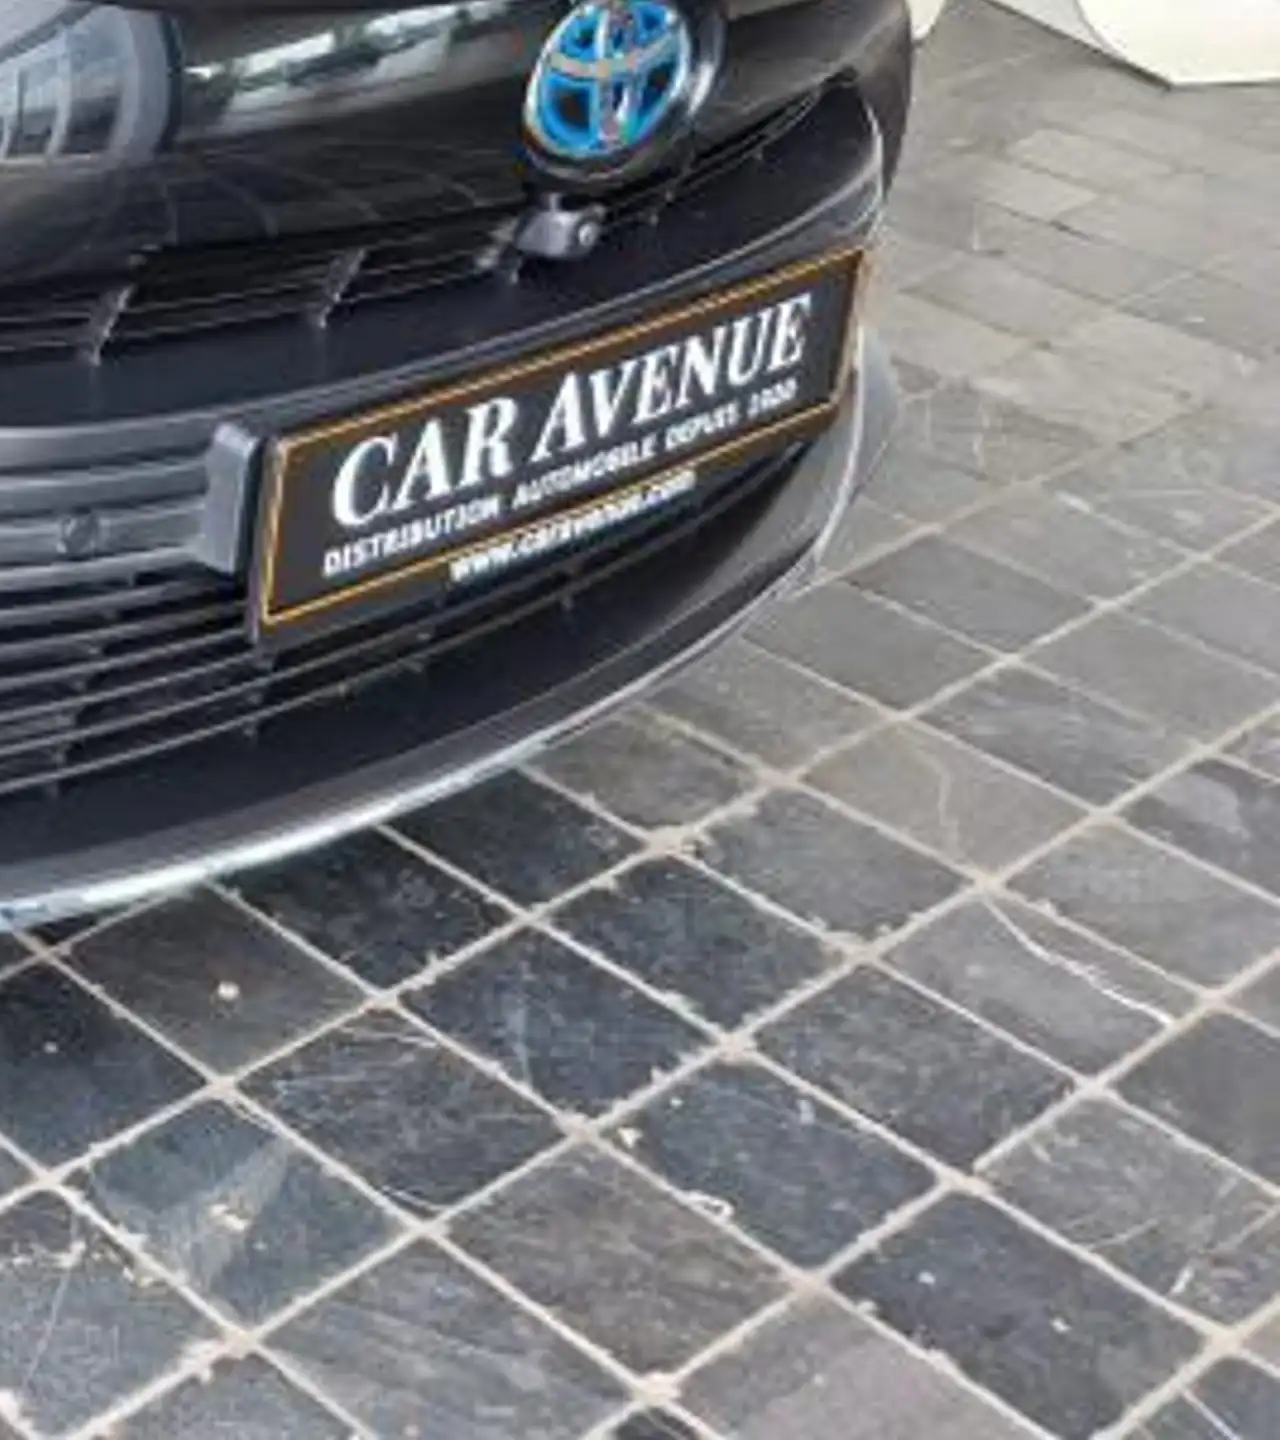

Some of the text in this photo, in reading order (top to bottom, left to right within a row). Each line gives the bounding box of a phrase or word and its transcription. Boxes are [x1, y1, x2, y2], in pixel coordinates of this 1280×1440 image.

[332, 292, 812, 528] CAR AVENUE
[322, 494, 501, 578] DISTRIBUTION
[511, 434, 658, 510] AUTOMOBILE
